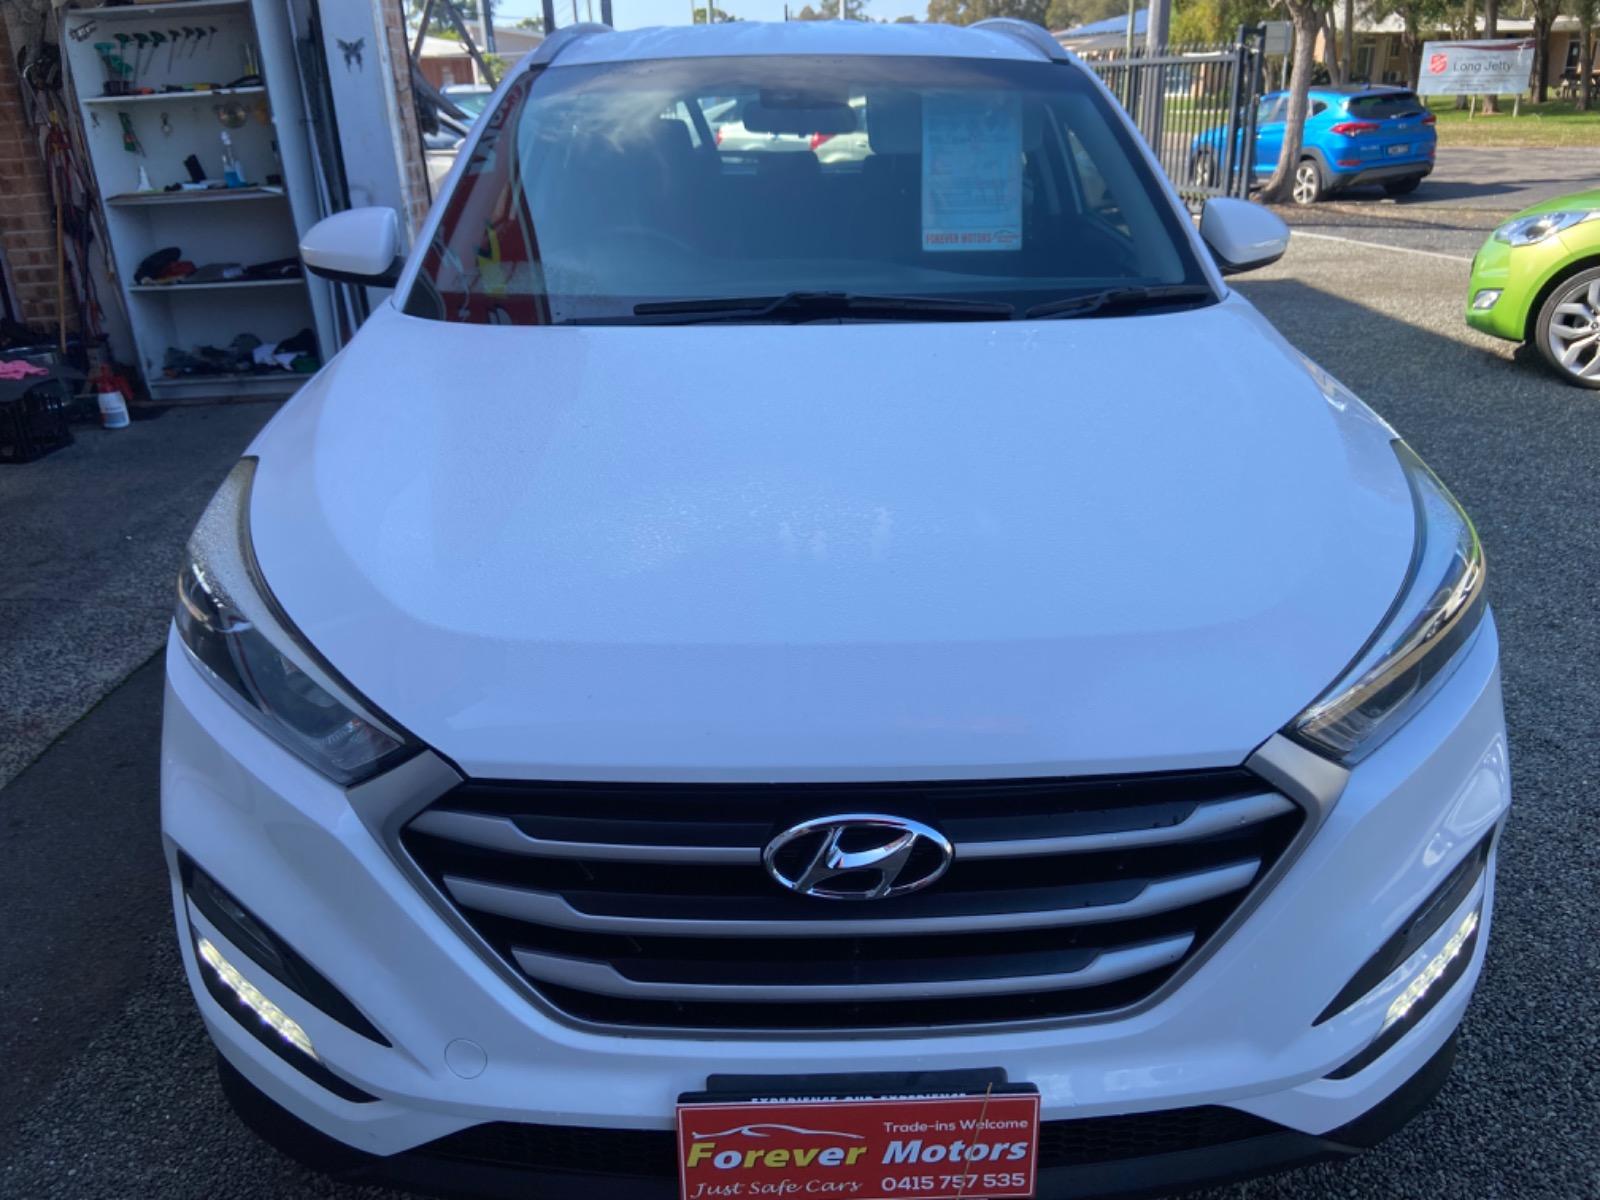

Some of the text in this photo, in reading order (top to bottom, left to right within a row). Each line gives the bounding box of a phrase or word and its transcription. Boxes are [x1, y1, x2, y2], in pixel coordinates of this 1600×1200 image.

[1453, 61, 1512, 73] Long Jetty
[883, 1118, 1029, 1133] Trade-ins Welcome
[686, 1138, 1029, 1169] Forever Motors
[689, 1177, 863, 1198] Just Safe Cars
[881, 1172, 1026, 1192] 0415 757 535
